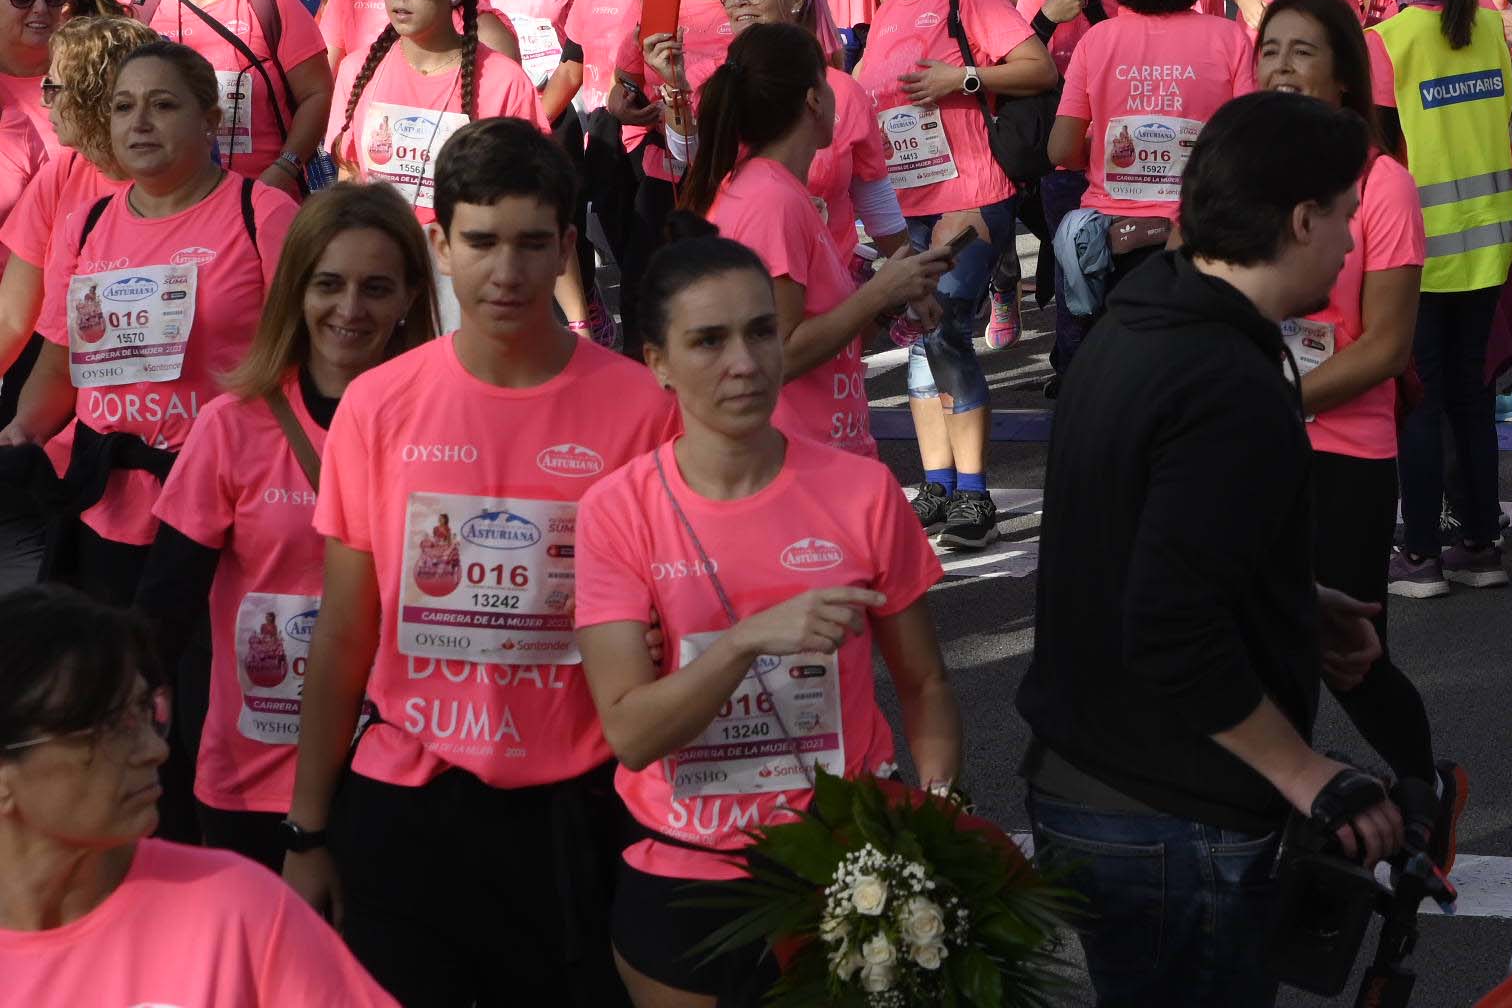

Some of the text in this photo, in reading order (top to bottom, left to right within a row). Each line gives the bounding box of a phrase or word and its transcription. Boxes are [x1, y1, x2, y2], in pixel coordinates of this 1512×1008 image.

[1116, 64, 1196, 80] CARRERA
[1131, 81, 1180, 95] DE LA
[1422, 76, 1503, 102] VOLUNTARIS
[1126, 96, 1183, 111] MUJER
[1137, 129, 1173, 139] ASTURIANA
[894, 137, 918, 151] 016
[396, 145, 431, 162] 016
[1138, 149, 1171, 162] 016
[1142, 165, 1167, 173] 15927
[106, 286, 154, 297] ASTURIANA
[108, 309, 149, 328] 016
[116, 332, 145, 344] 15570
[85, 350, 120, 362] CARRERA
[122, 349, 131, 357] DE
[82, 367, 123, 380] OYSHO
[403, 445, 478, 463] OYSHO
[541, 452, 599, 472] ASTURIANA
[264, 488, 316, 505] OYSH
[467, 524, 535, 542] ASTURIANA
[786, 550, 841, 565] ASTURIANA
[467, 562, 529, 587] 016
[651, 559, 718, 580] OYSHO
[472, 593, 520, 609] 13242
[422, 611, 471, 622] CARRERA
[474, 616, 487, 624] DE
[491, 617, 504, 625] LA
[507, 617, 543, 627] MUJER
[416, 632, 471, 649] OYSHO
[517, 640, 569, 650] Santander
[408, 655, 564, 689] DORSAL
[253, 700, 299, 711] CARRERA
[405, 697, 521, 742] SUMA
[723, 723, 769, 740] 13240
[678, 747, 724, 761] CARRERA
[727, 746, 743, 757] DE
[745, 745, 758, 755] LA
[668, 794, 803, 834] SUMA
